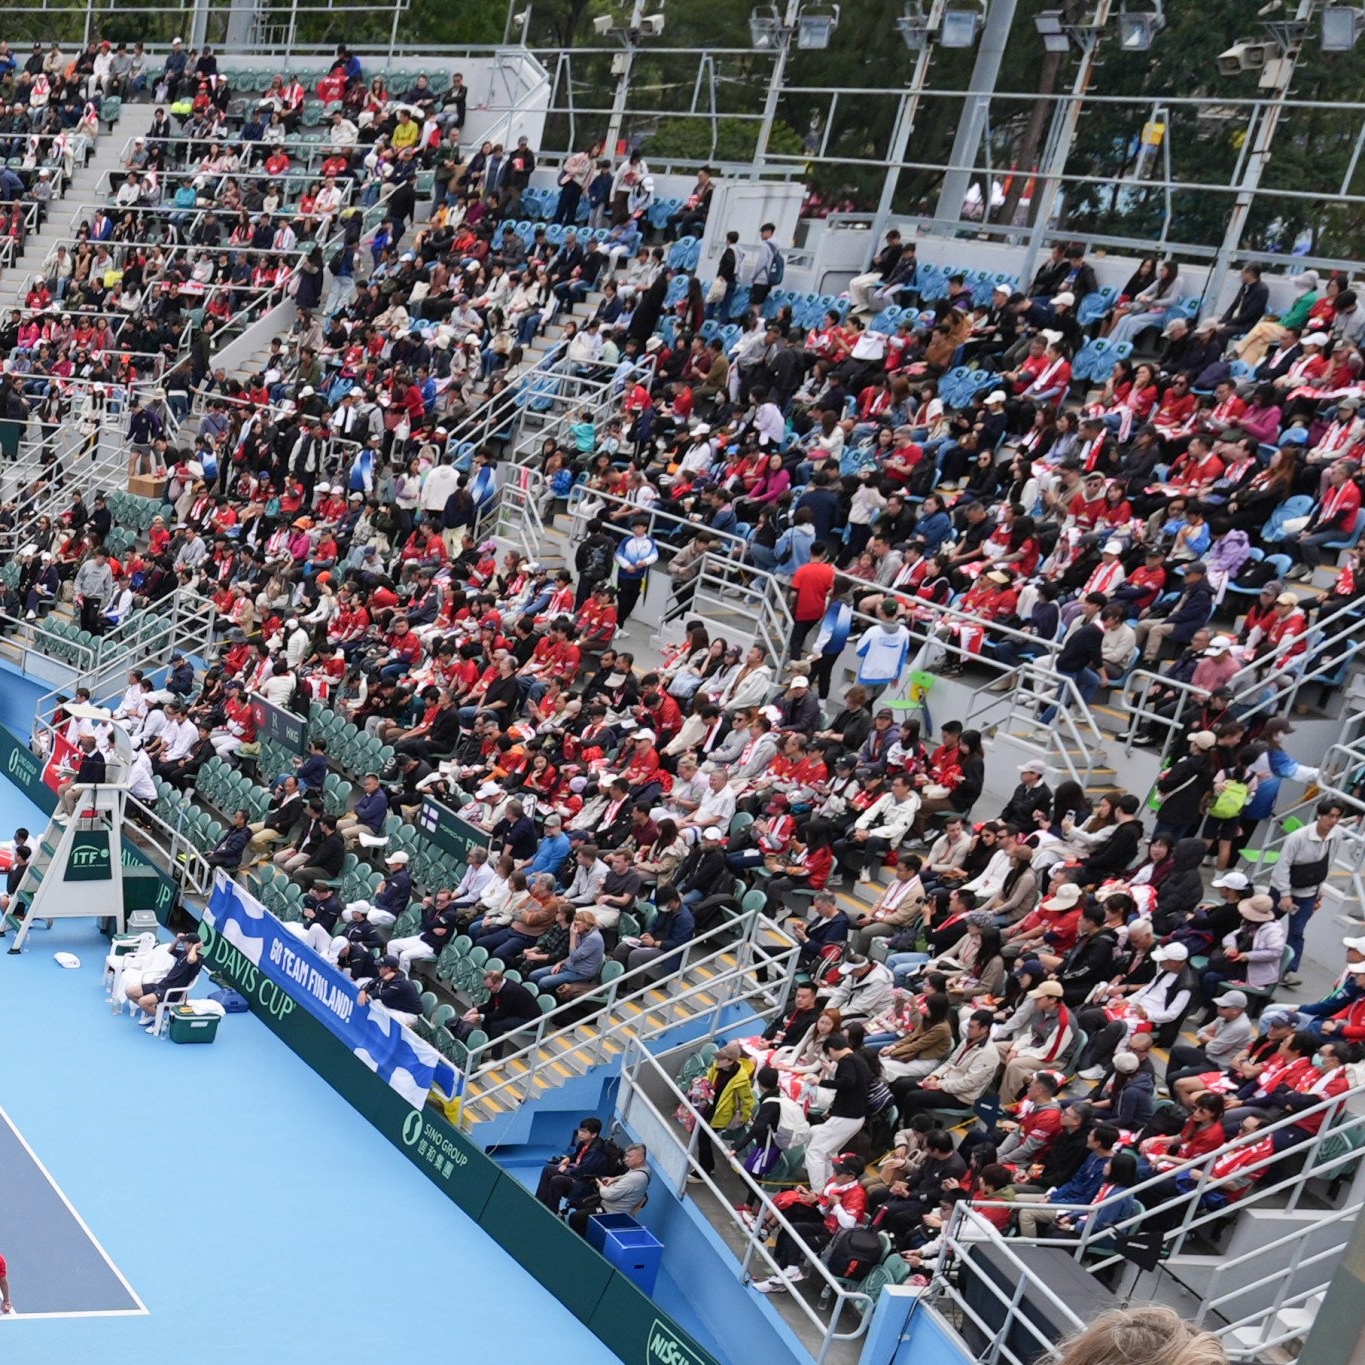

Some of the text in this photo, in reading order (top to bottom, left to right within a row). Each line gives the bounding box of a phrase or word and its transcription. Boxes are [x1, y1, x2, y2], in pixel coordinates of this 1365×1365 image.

[285, 726, 299, 743] HKG
[73, 852, 98, 864] ITF
[215, 938, 294, 1021] DAVIS CUP
[271, 937, 354, 1023] GO TEAM FINLAND!
[417, 1138, 454, 1180] 信和集團
[424, 1124, 468, 1166] SINO GROUP
